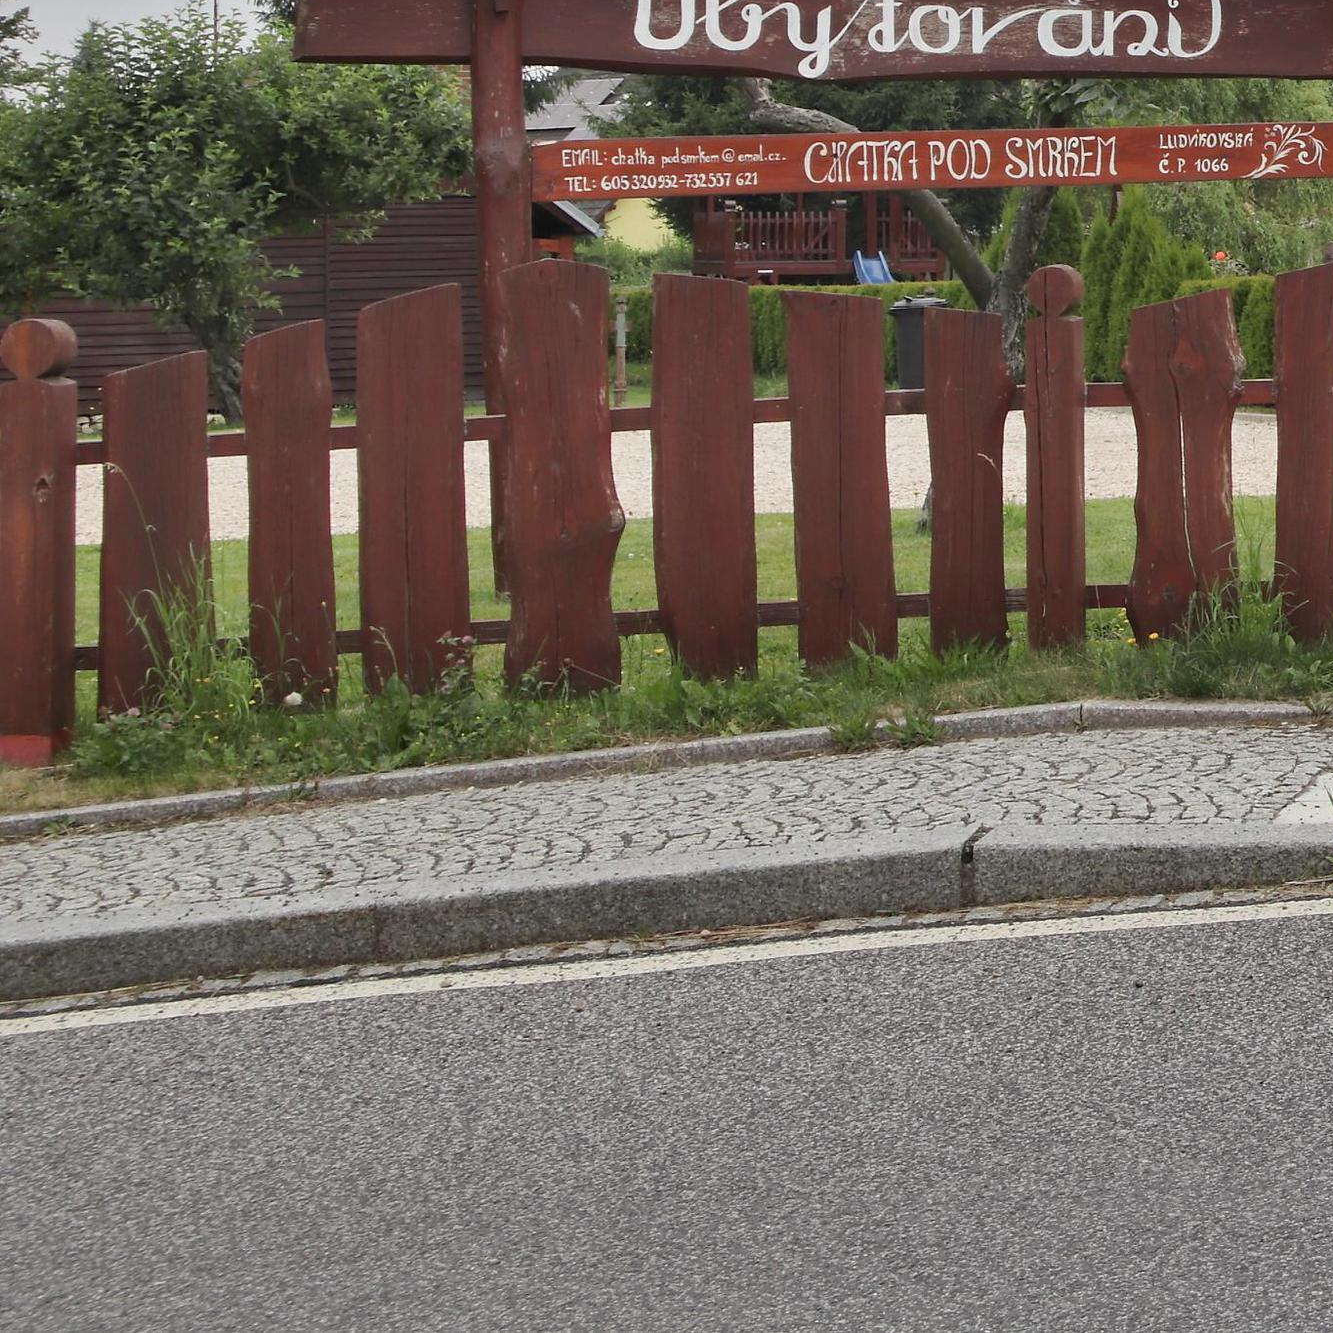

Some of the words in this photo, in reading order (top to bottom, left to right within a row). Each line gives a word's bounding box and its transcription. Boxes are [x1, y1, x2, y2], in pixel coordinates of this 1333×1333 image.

[562, 148, 608, 167] EMAIL:
[804, 140, 918, 184] CHATKA
[928, 139, 991, 181] POD
[1005, 136, 1118, 179] SMRKEM
[1194, 158, 1229, 173] 1066
[564, 175, 598, 192] TEL:
